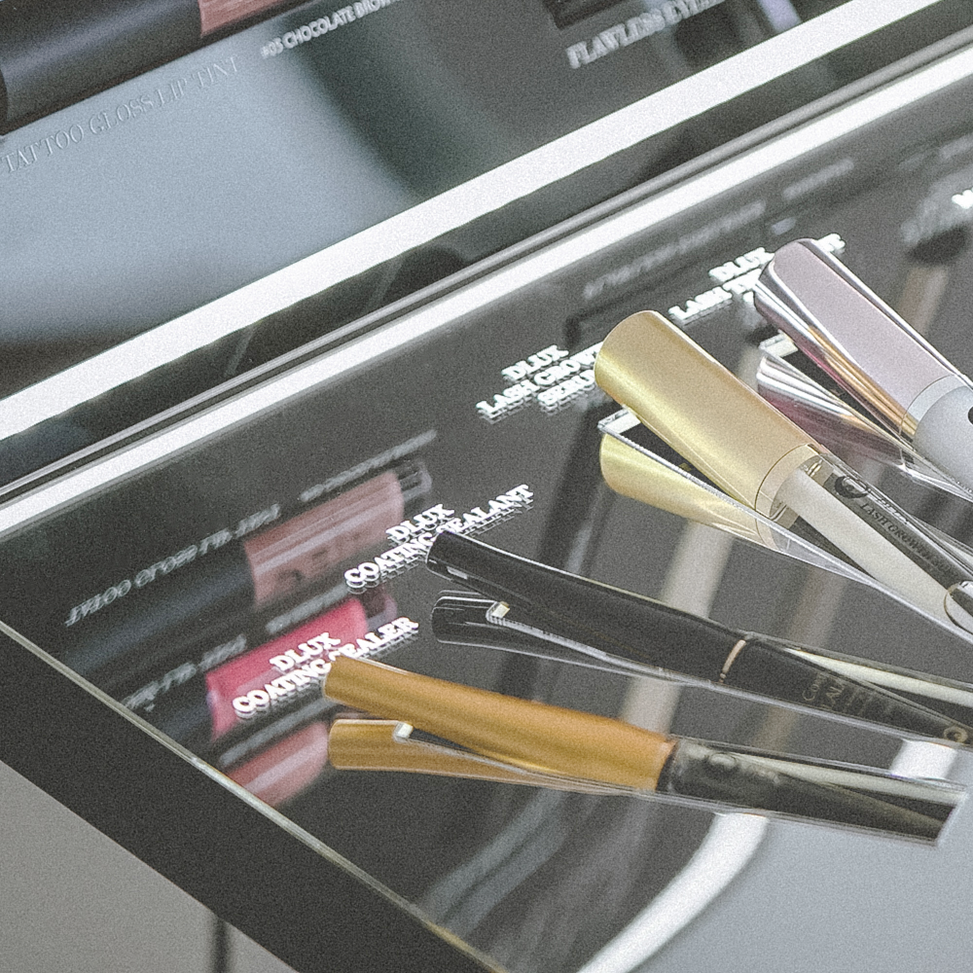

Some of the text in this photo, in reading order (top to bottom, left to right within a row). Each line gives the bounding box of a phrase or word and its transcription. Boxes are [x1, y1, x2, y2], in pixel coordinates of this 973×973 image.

[1, 124, 84, 173] TATTOO
[89, 94, 153, 135] GLOSS
[156, 78, 188, 107] LIP
[190, 56, 239, 89] TINT
[282, 5, 356, 49] CHOCOLATE
[502, 345, 569, 381] DLUX
[475, 379, 540, 414] LASH
[537, 369, 596, 406] SERU
[386, 503, 454, 540] DLUX
[859, 500, 890, 527] LASH
[269, 632, 341, 672] DLUX
[232, 658, 331, 713] COATING
